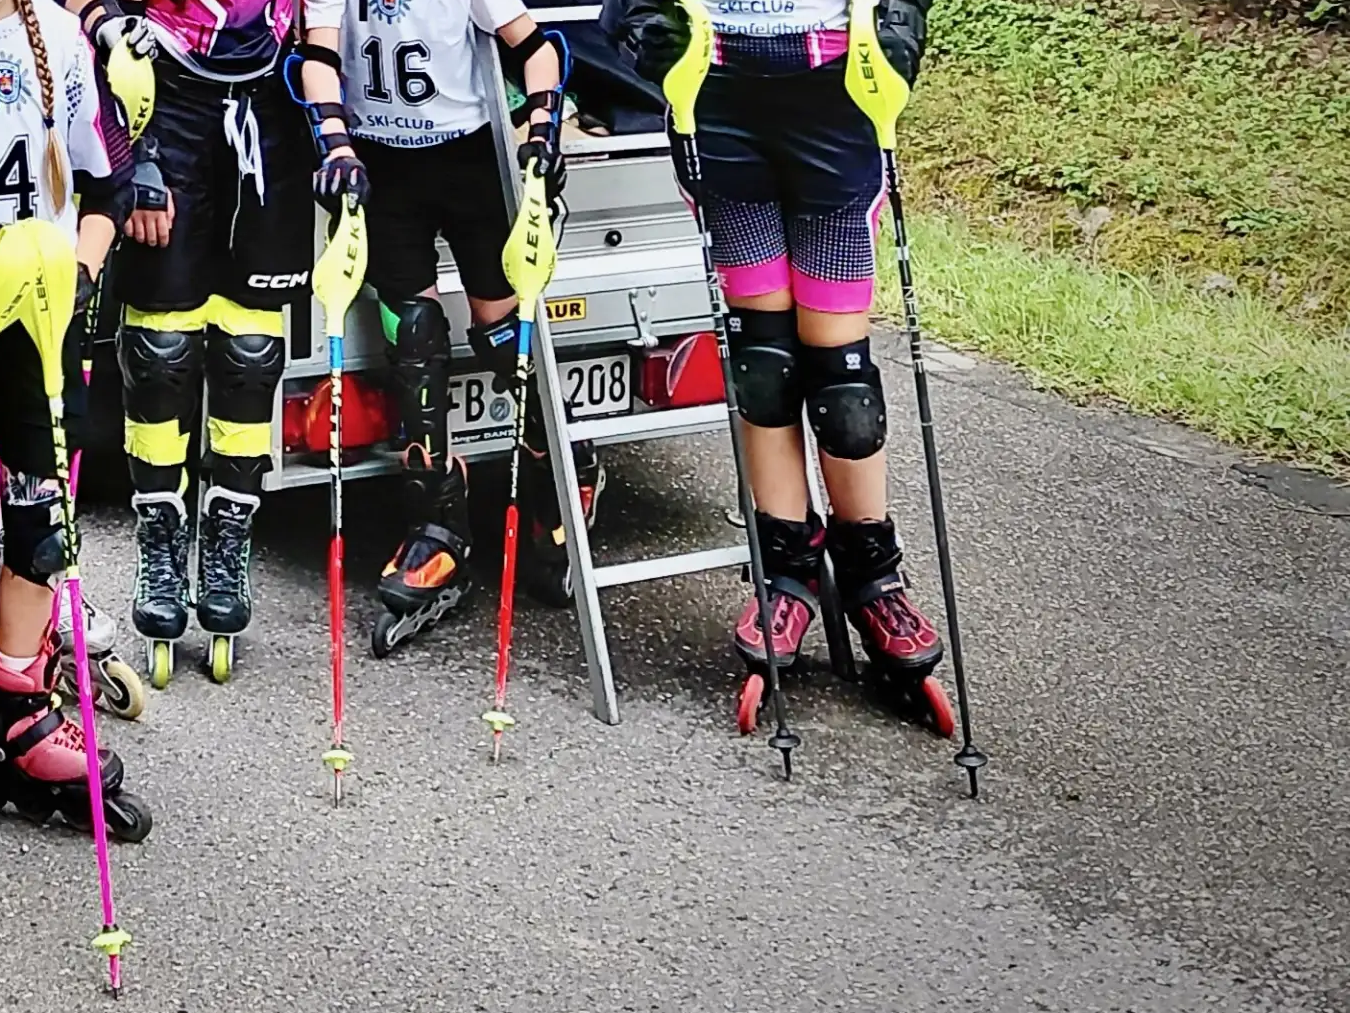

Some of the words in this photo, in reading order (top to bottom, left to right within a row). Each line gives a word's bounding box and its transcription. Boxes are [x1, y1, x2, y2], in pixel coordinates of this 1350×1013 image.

[718, 0, 795, 14] SKI-CLUB
[360, 36, 440, 106] 16
[857, 42, 879, 94] LEKI
[366, 114, 435, 130] SKI-CLUB
[525, 196, 542, 267] LEKI
[247, 271, 309, 289] CCM
[567, 360, 626, 409] 208
